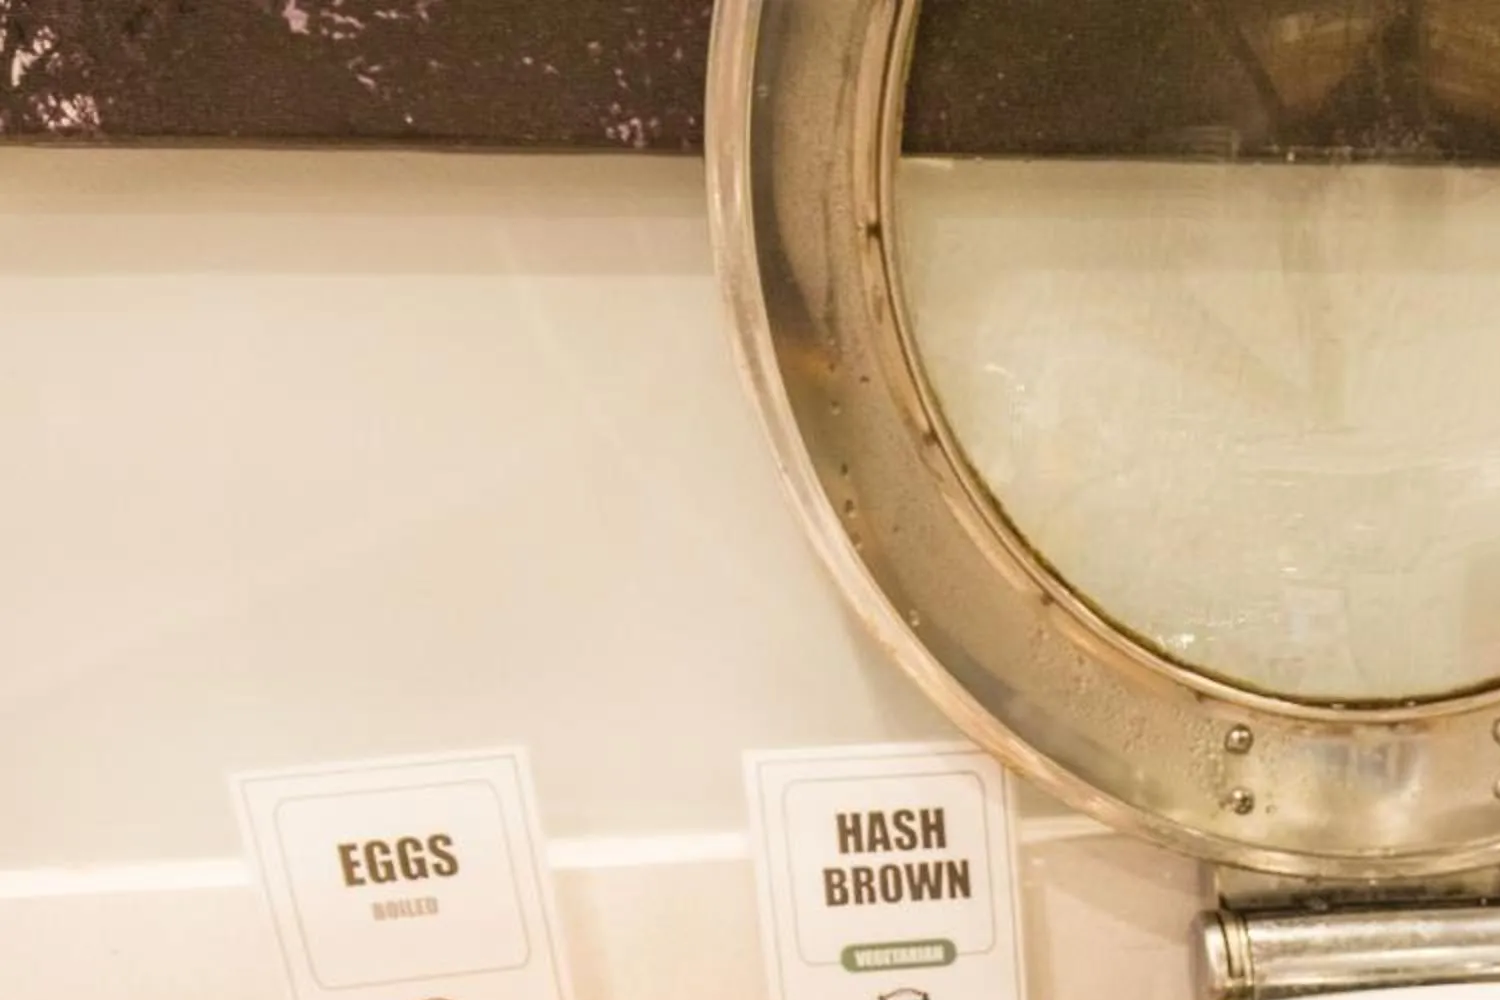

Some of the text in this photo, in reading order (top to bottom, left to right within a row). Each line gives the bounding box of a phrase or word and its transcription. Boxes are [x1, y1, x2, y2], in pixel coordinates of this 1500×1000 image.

[836, 808, 947, 854] HASH
[337, 833, 459, 887] EGGS
[822, 859, 972, 906] BROWN
